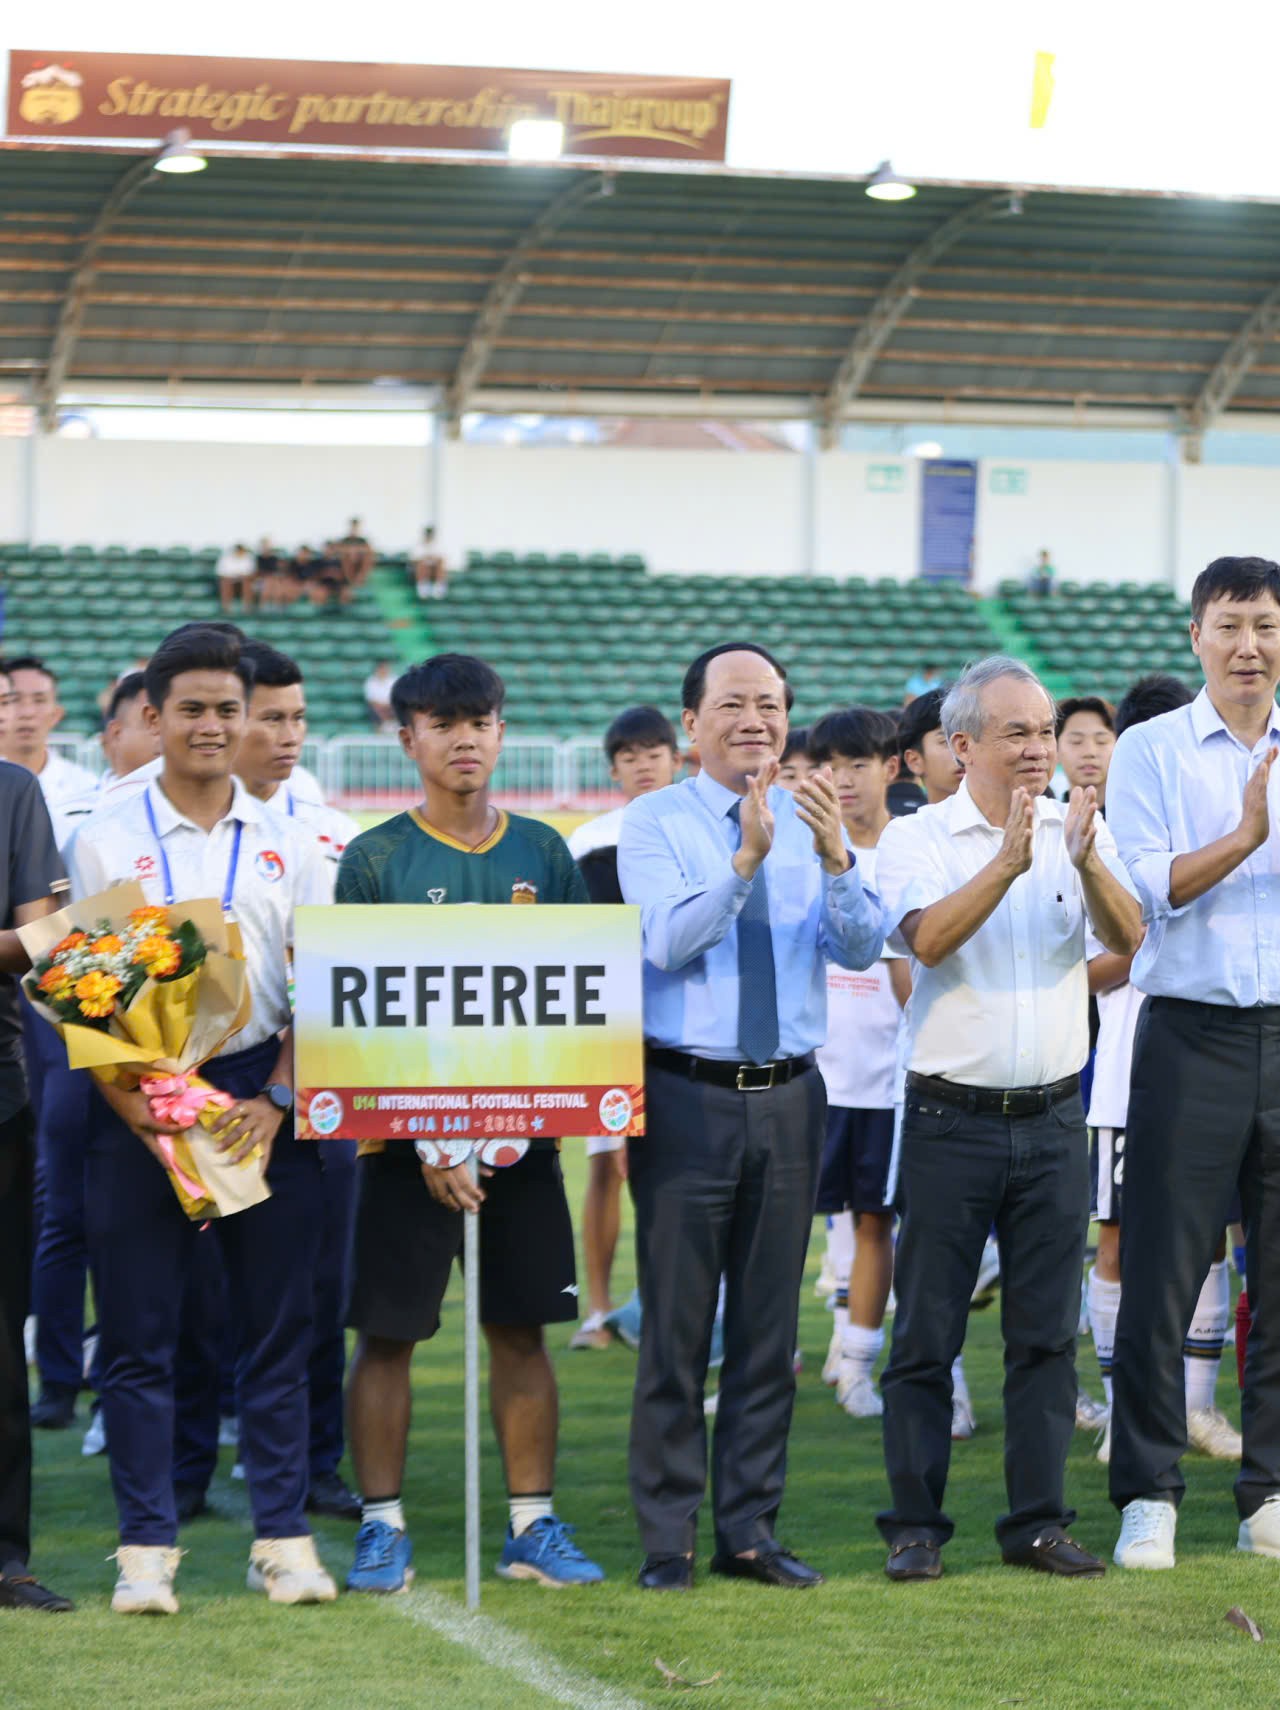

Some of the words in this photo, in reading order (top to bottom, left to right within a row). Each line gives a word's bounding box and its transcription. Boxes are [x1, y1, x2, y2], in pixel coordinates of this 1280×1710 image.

[98, 76, 290, 132] Strategic
[331, 965, 606, 1027] REFEREE
[353, 1095, 376, 1110] U14
[378, 1094, 470, 1110] INTERNATIONAL
[472, 1094, 532, 1109] FOOTBALL
[534, 1093, 588, 1109] FESTIVAL
[408, 1116, 436, 1132] GIA
[443, 1116, 470, 1131] LAI
[484, 1115, 527, 1132] 2026
